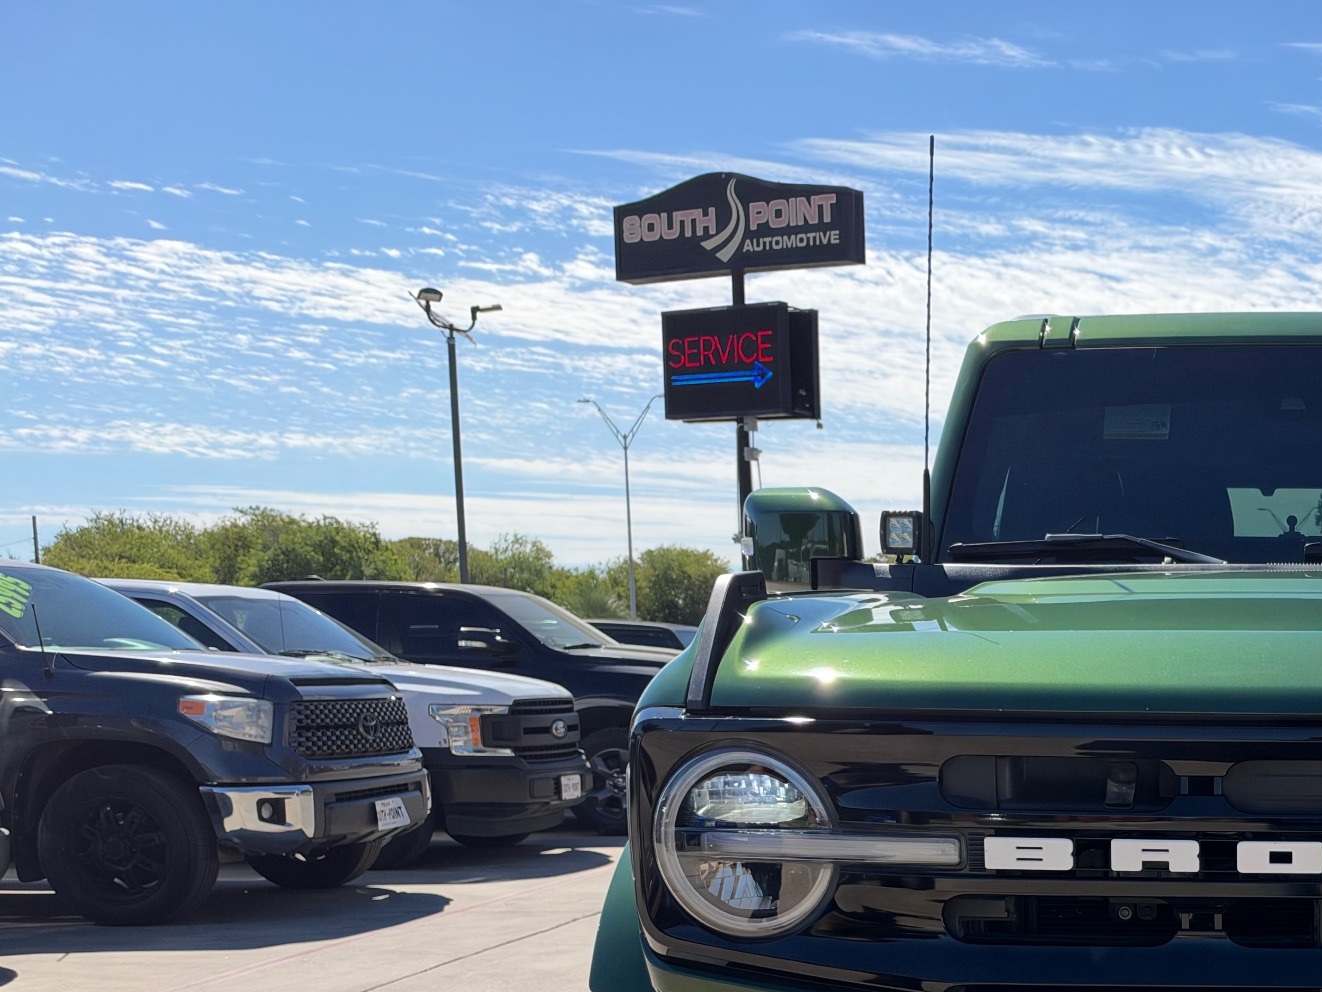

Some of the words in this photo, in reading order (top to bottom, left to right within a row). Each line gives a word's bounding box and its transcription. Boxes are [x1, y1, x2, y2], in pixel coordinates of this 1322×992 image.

[623, 207, 716, 244] SOUTH
[750, 193, 837, 231] POINT
[742, 230, 840, 252] AUTOMOTIVE
[668, 330, 774, 368] SERVICE
